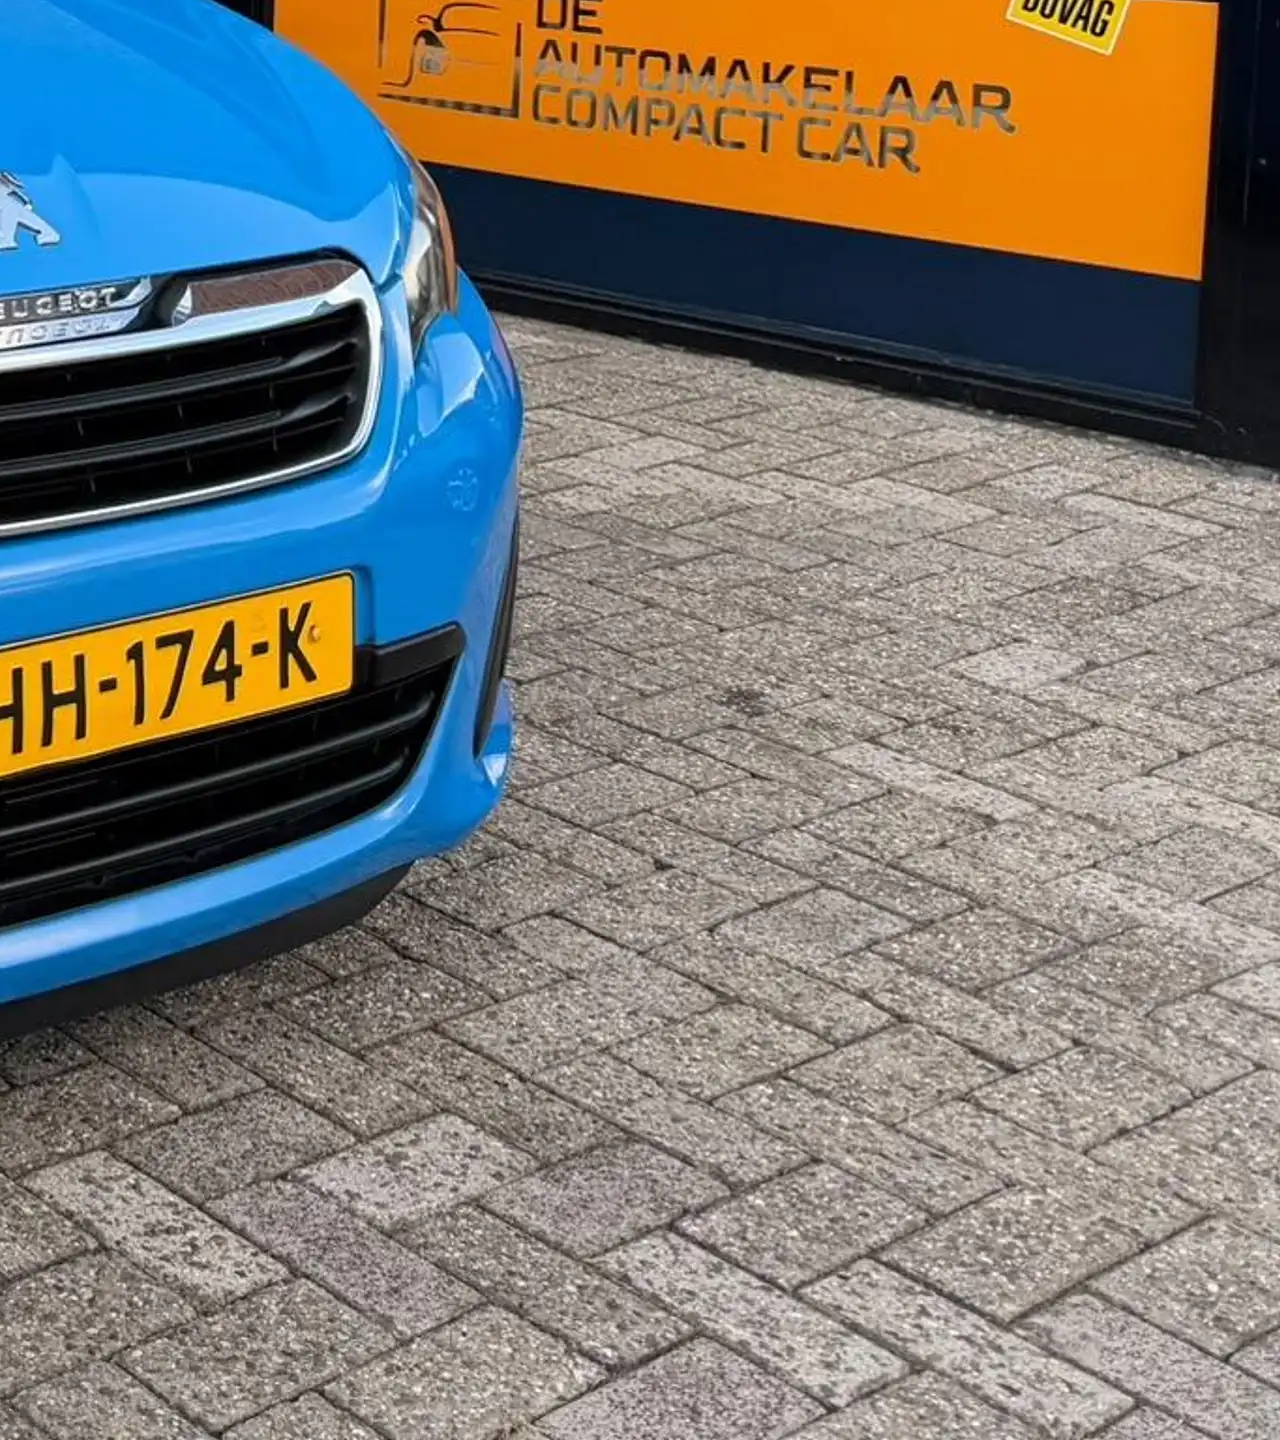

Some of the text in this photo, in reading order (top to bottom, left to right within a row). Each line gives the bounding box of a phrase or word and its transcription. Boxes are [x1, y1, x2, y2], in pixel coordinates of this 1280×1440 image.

[532, 84, 921, 174] COMPACT CAR
[534, 39, 1017, 135] AUTOMAKELAAR
